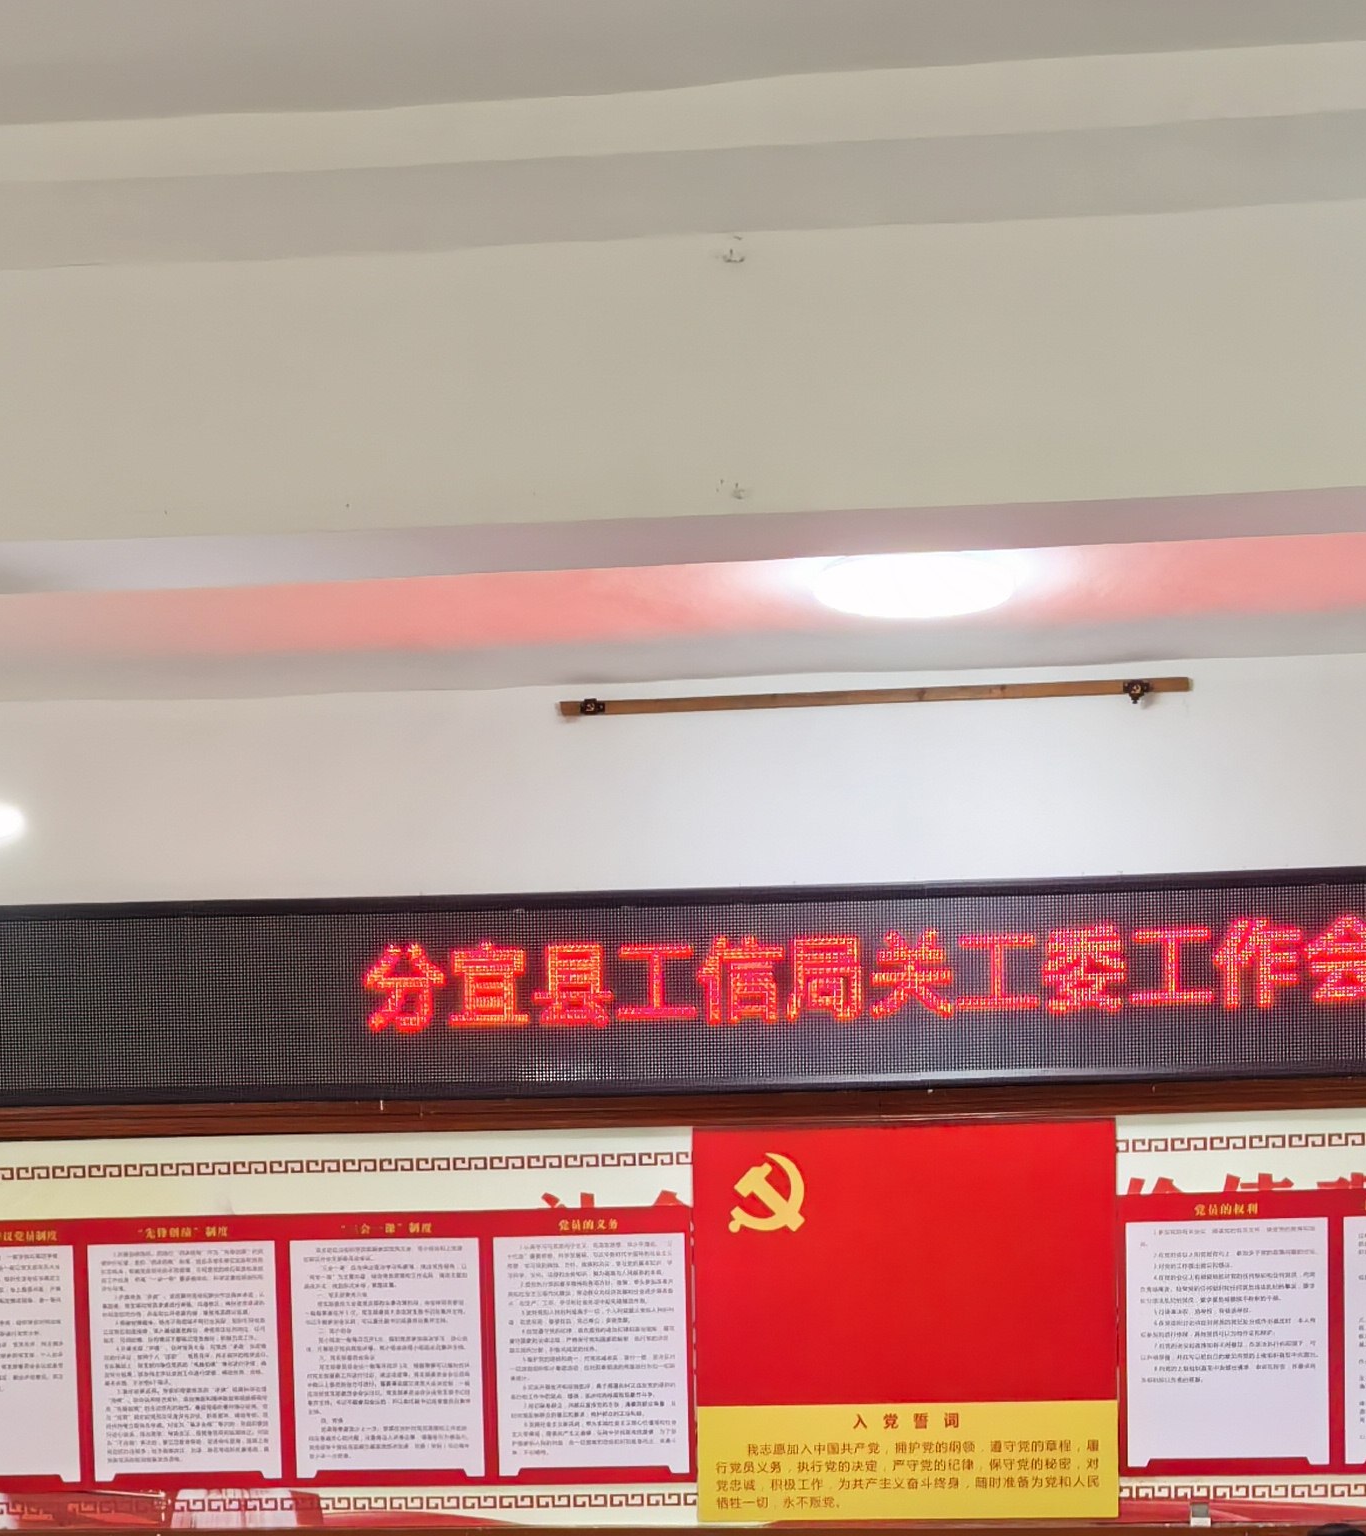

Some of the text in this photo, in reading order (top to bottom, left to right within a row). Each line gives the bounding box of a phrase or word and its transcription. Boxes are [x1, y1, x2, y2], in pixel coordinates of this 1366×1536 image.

[1194, 1203, 1258, 1216] 党员的权利
[557, 1219, 619, 1232] 党员的义务
[852, 1412, 961, 1430] 入党誓词
